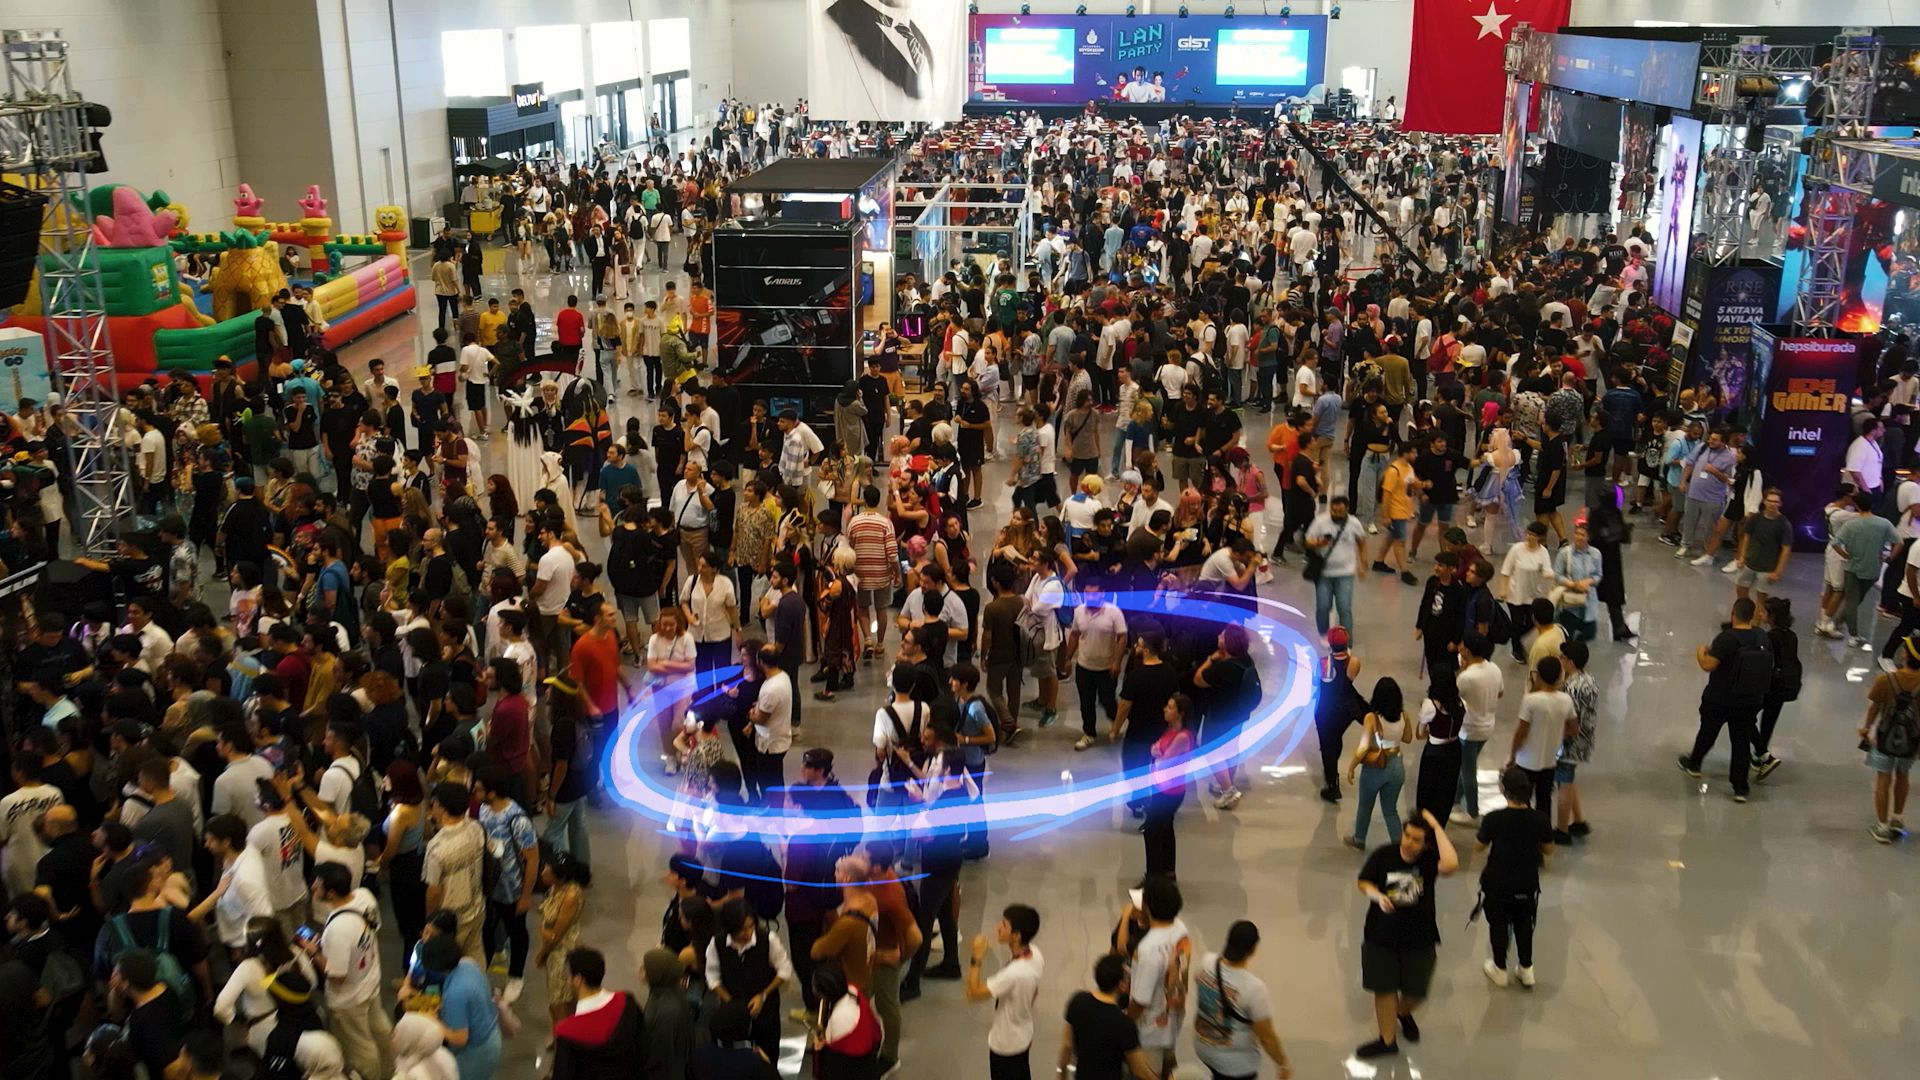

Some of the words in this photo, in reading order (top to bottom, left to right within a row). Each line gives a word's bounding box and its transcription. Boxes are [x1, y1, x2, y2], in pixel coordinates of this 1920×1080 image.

[1120, 23, 1163, 47] LAN
[1177, 34, 1211, 48] GIST
[1118, 42, 1162, 61] PARTY
[771, 277, 803, 286] AORUS
[1726, 280, 1764, 294] RISE
[1717, 306, 1725, 314] 5
[1716, 314, 1763, 324] YAYILAN
[1779, 340, 1856, 353] hepsiburada
[1772, 392, 1848, 413] GAMER
[1788, 426, 1822, 441] intel
